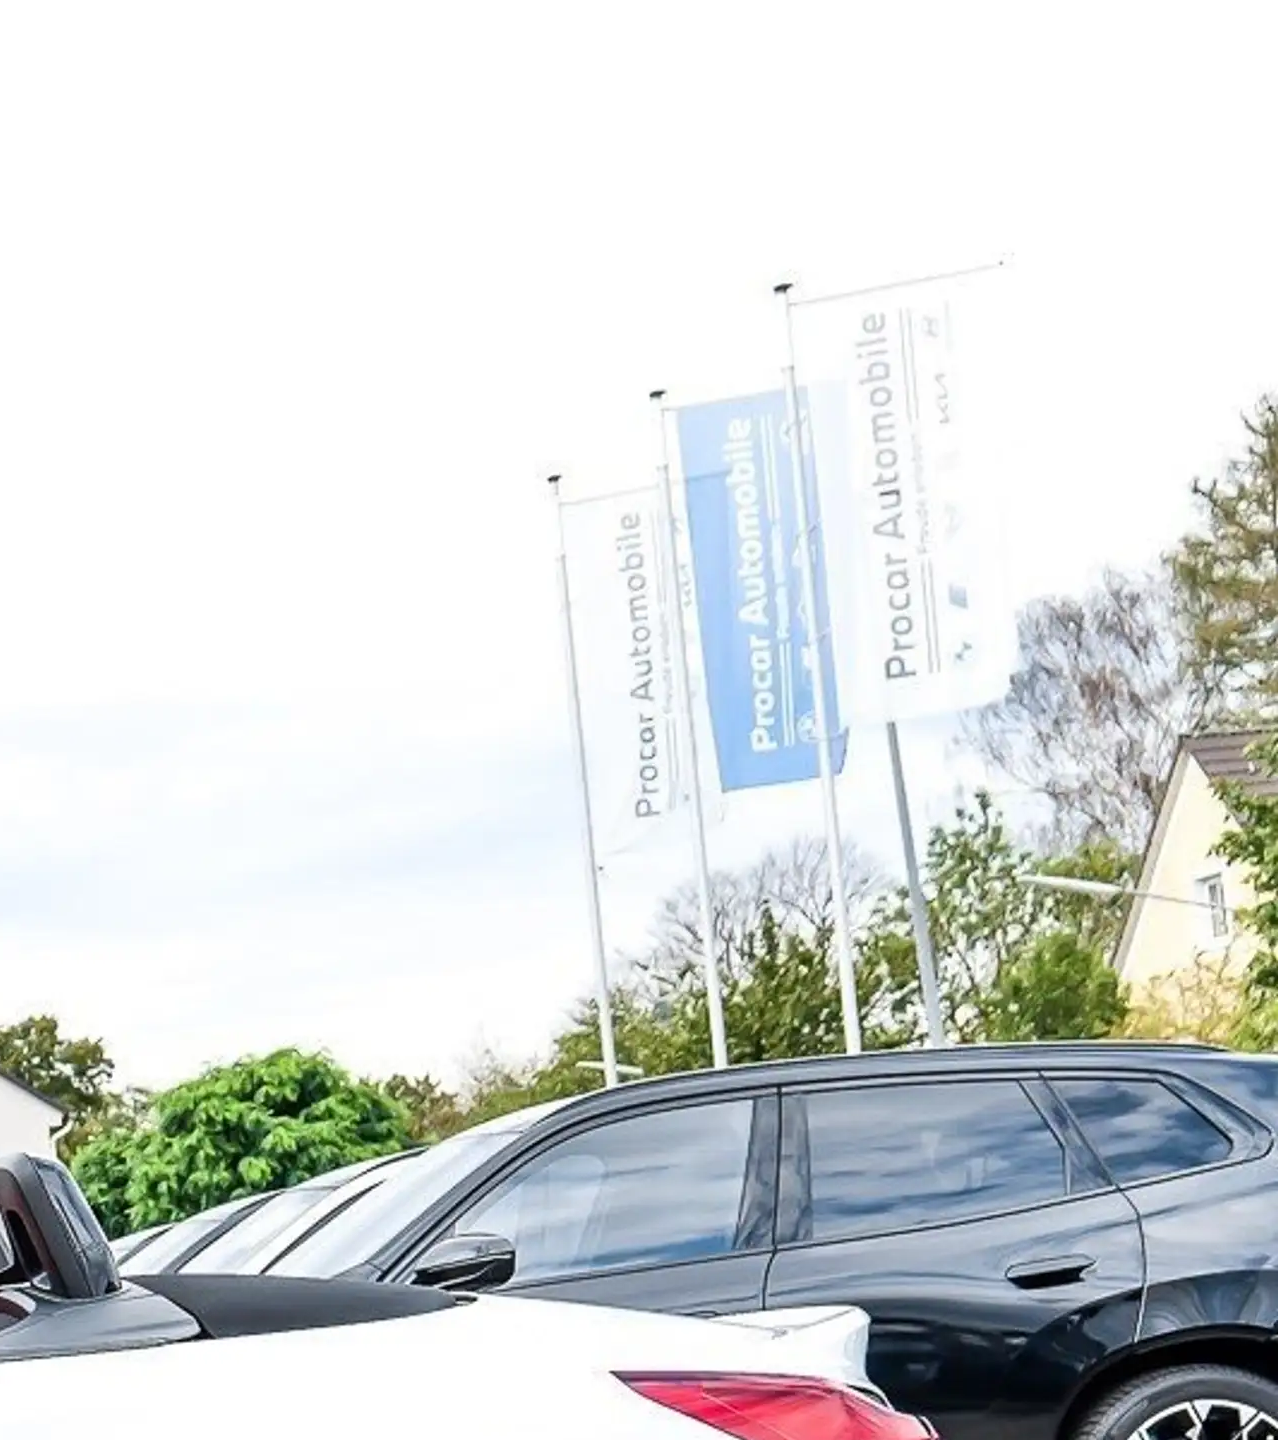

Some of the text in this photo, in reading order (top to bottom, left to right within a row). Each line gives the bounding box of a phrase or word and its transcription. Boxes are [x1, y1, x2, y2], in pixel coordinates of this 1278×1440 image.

[722, 417, 778, 754] Procar Automobile
[855, 311, 917, 681] Procar Automobile
[616, 511, 661, 819] Procar Automobile
